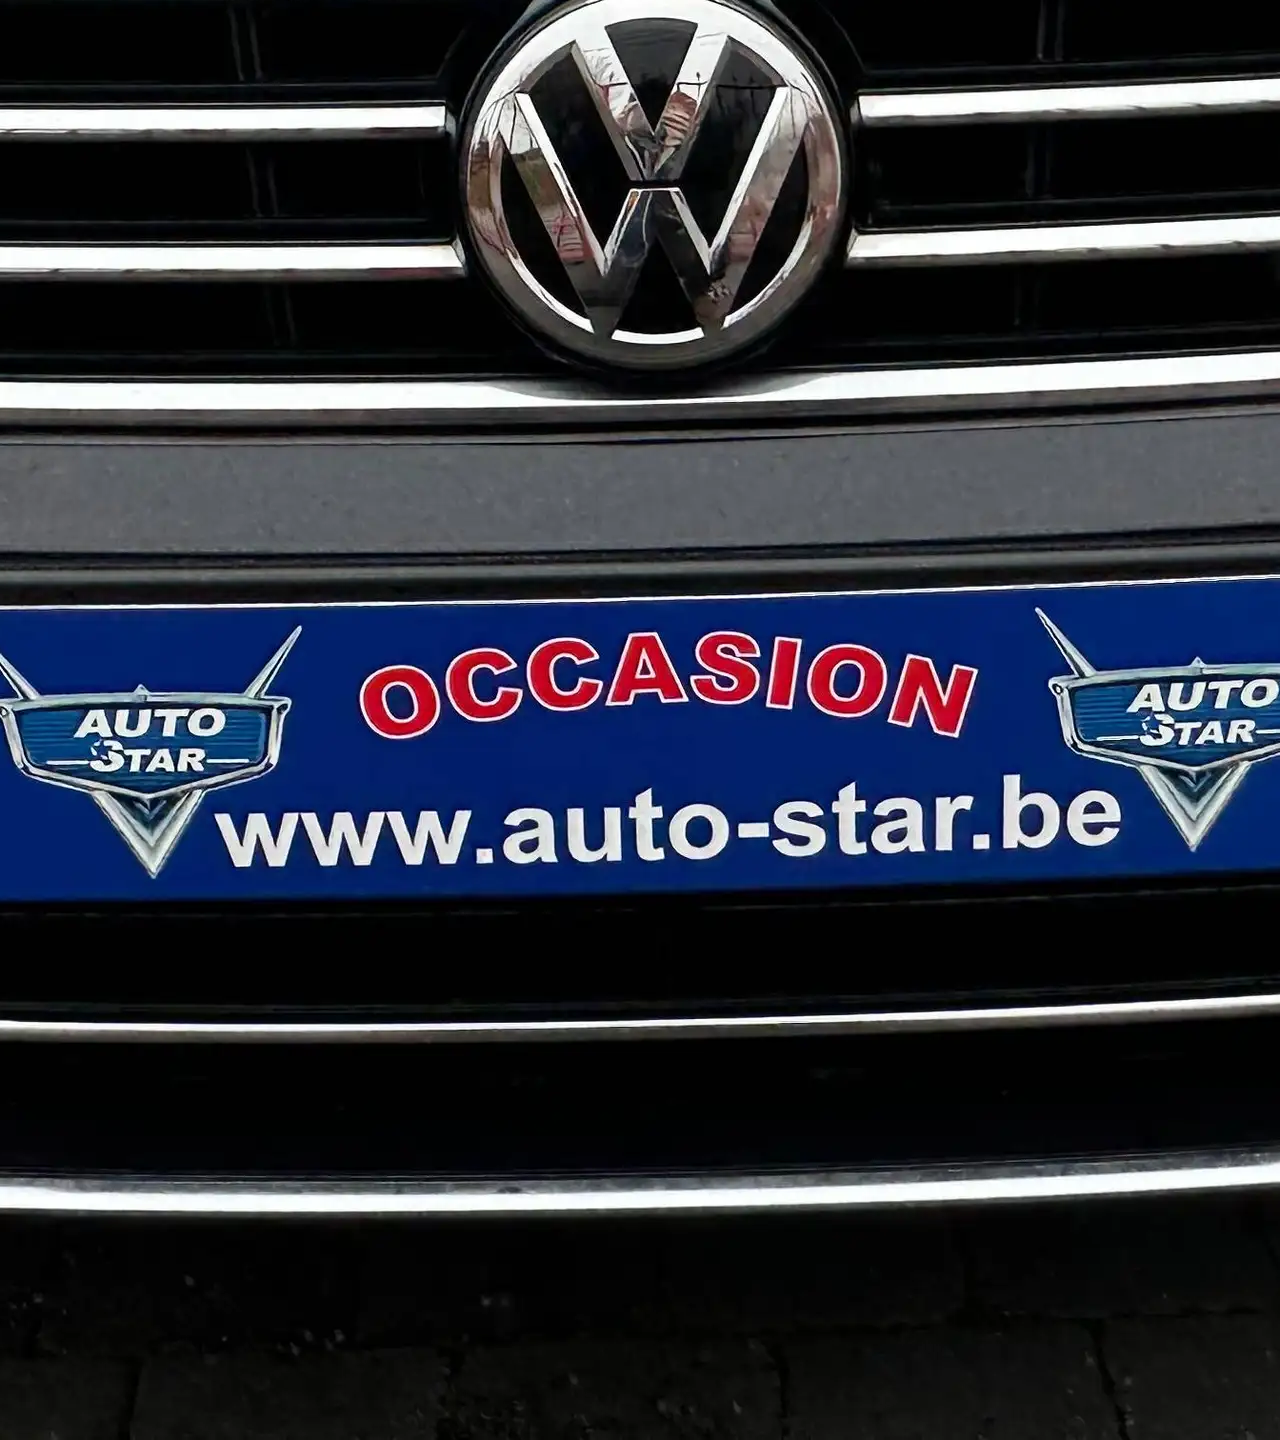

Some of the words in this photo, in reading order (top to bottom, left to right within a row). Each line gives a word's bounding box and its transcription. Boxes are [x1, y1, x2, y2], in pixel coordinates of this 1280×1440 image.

[359, 630, 979, 739] OCCASION
[1126, 678, 1280, 713] AUTO
[73, 707, 227, 739] AUTO
[213, 773, 1122, 868] www.auto-star.be
